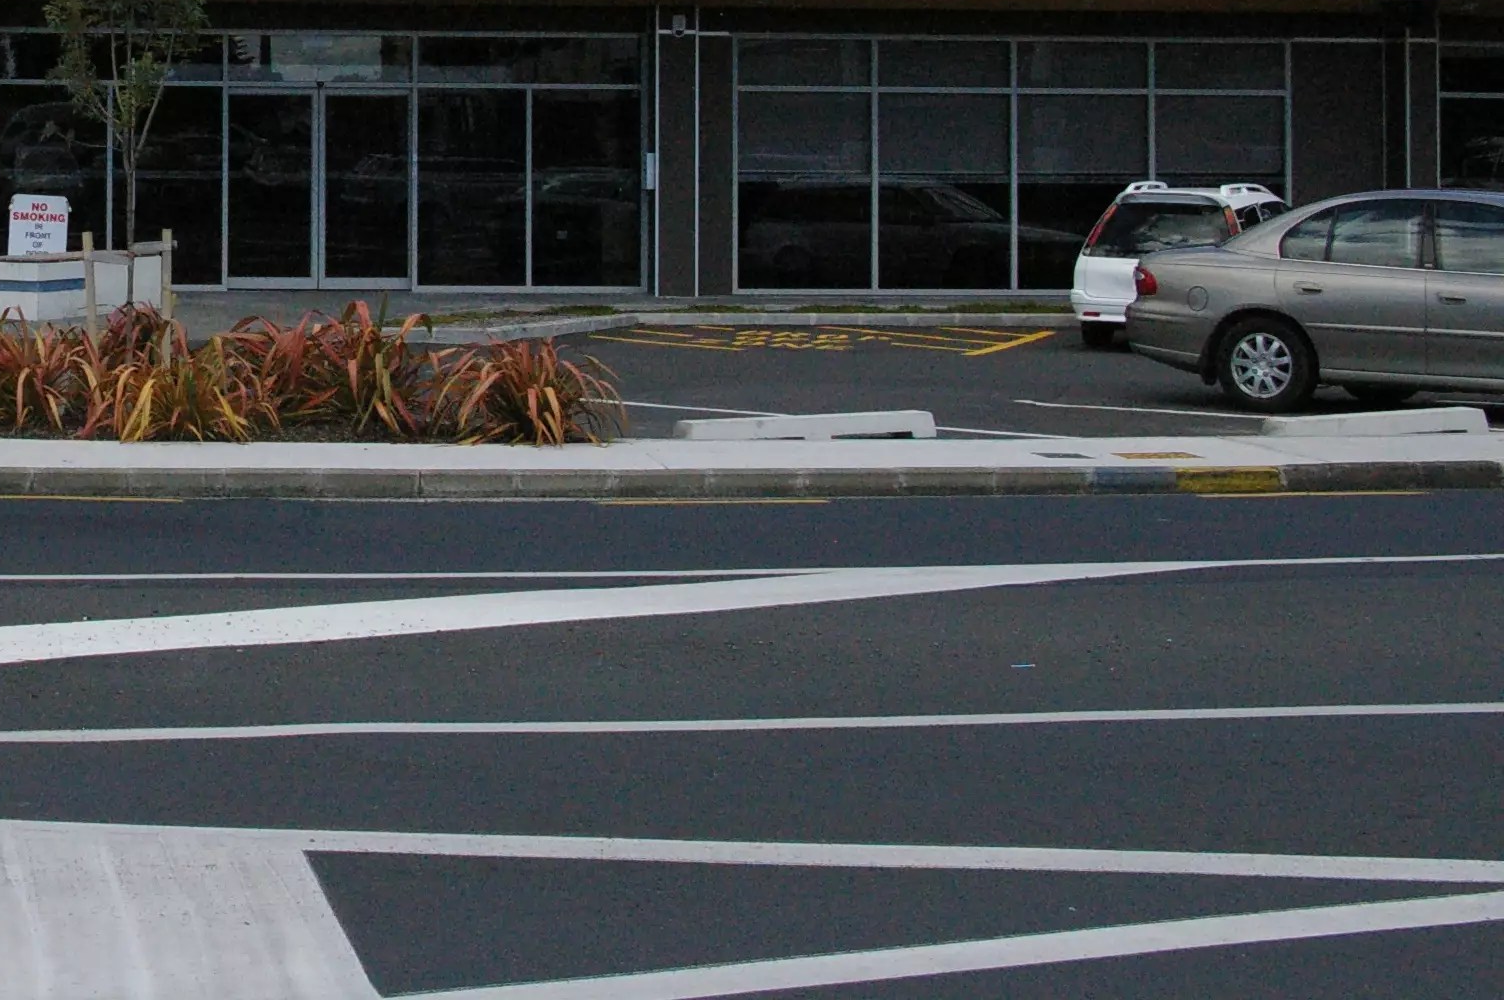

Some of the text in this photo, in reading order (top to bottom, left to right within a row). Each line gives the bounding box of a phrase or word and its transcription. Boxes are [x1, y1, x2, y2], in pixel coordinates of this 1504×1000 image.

[31, 203, 48, 212] NO
[13, 212, 65, 222] SMOKING
[25, 232, 51, 240] FRONT
